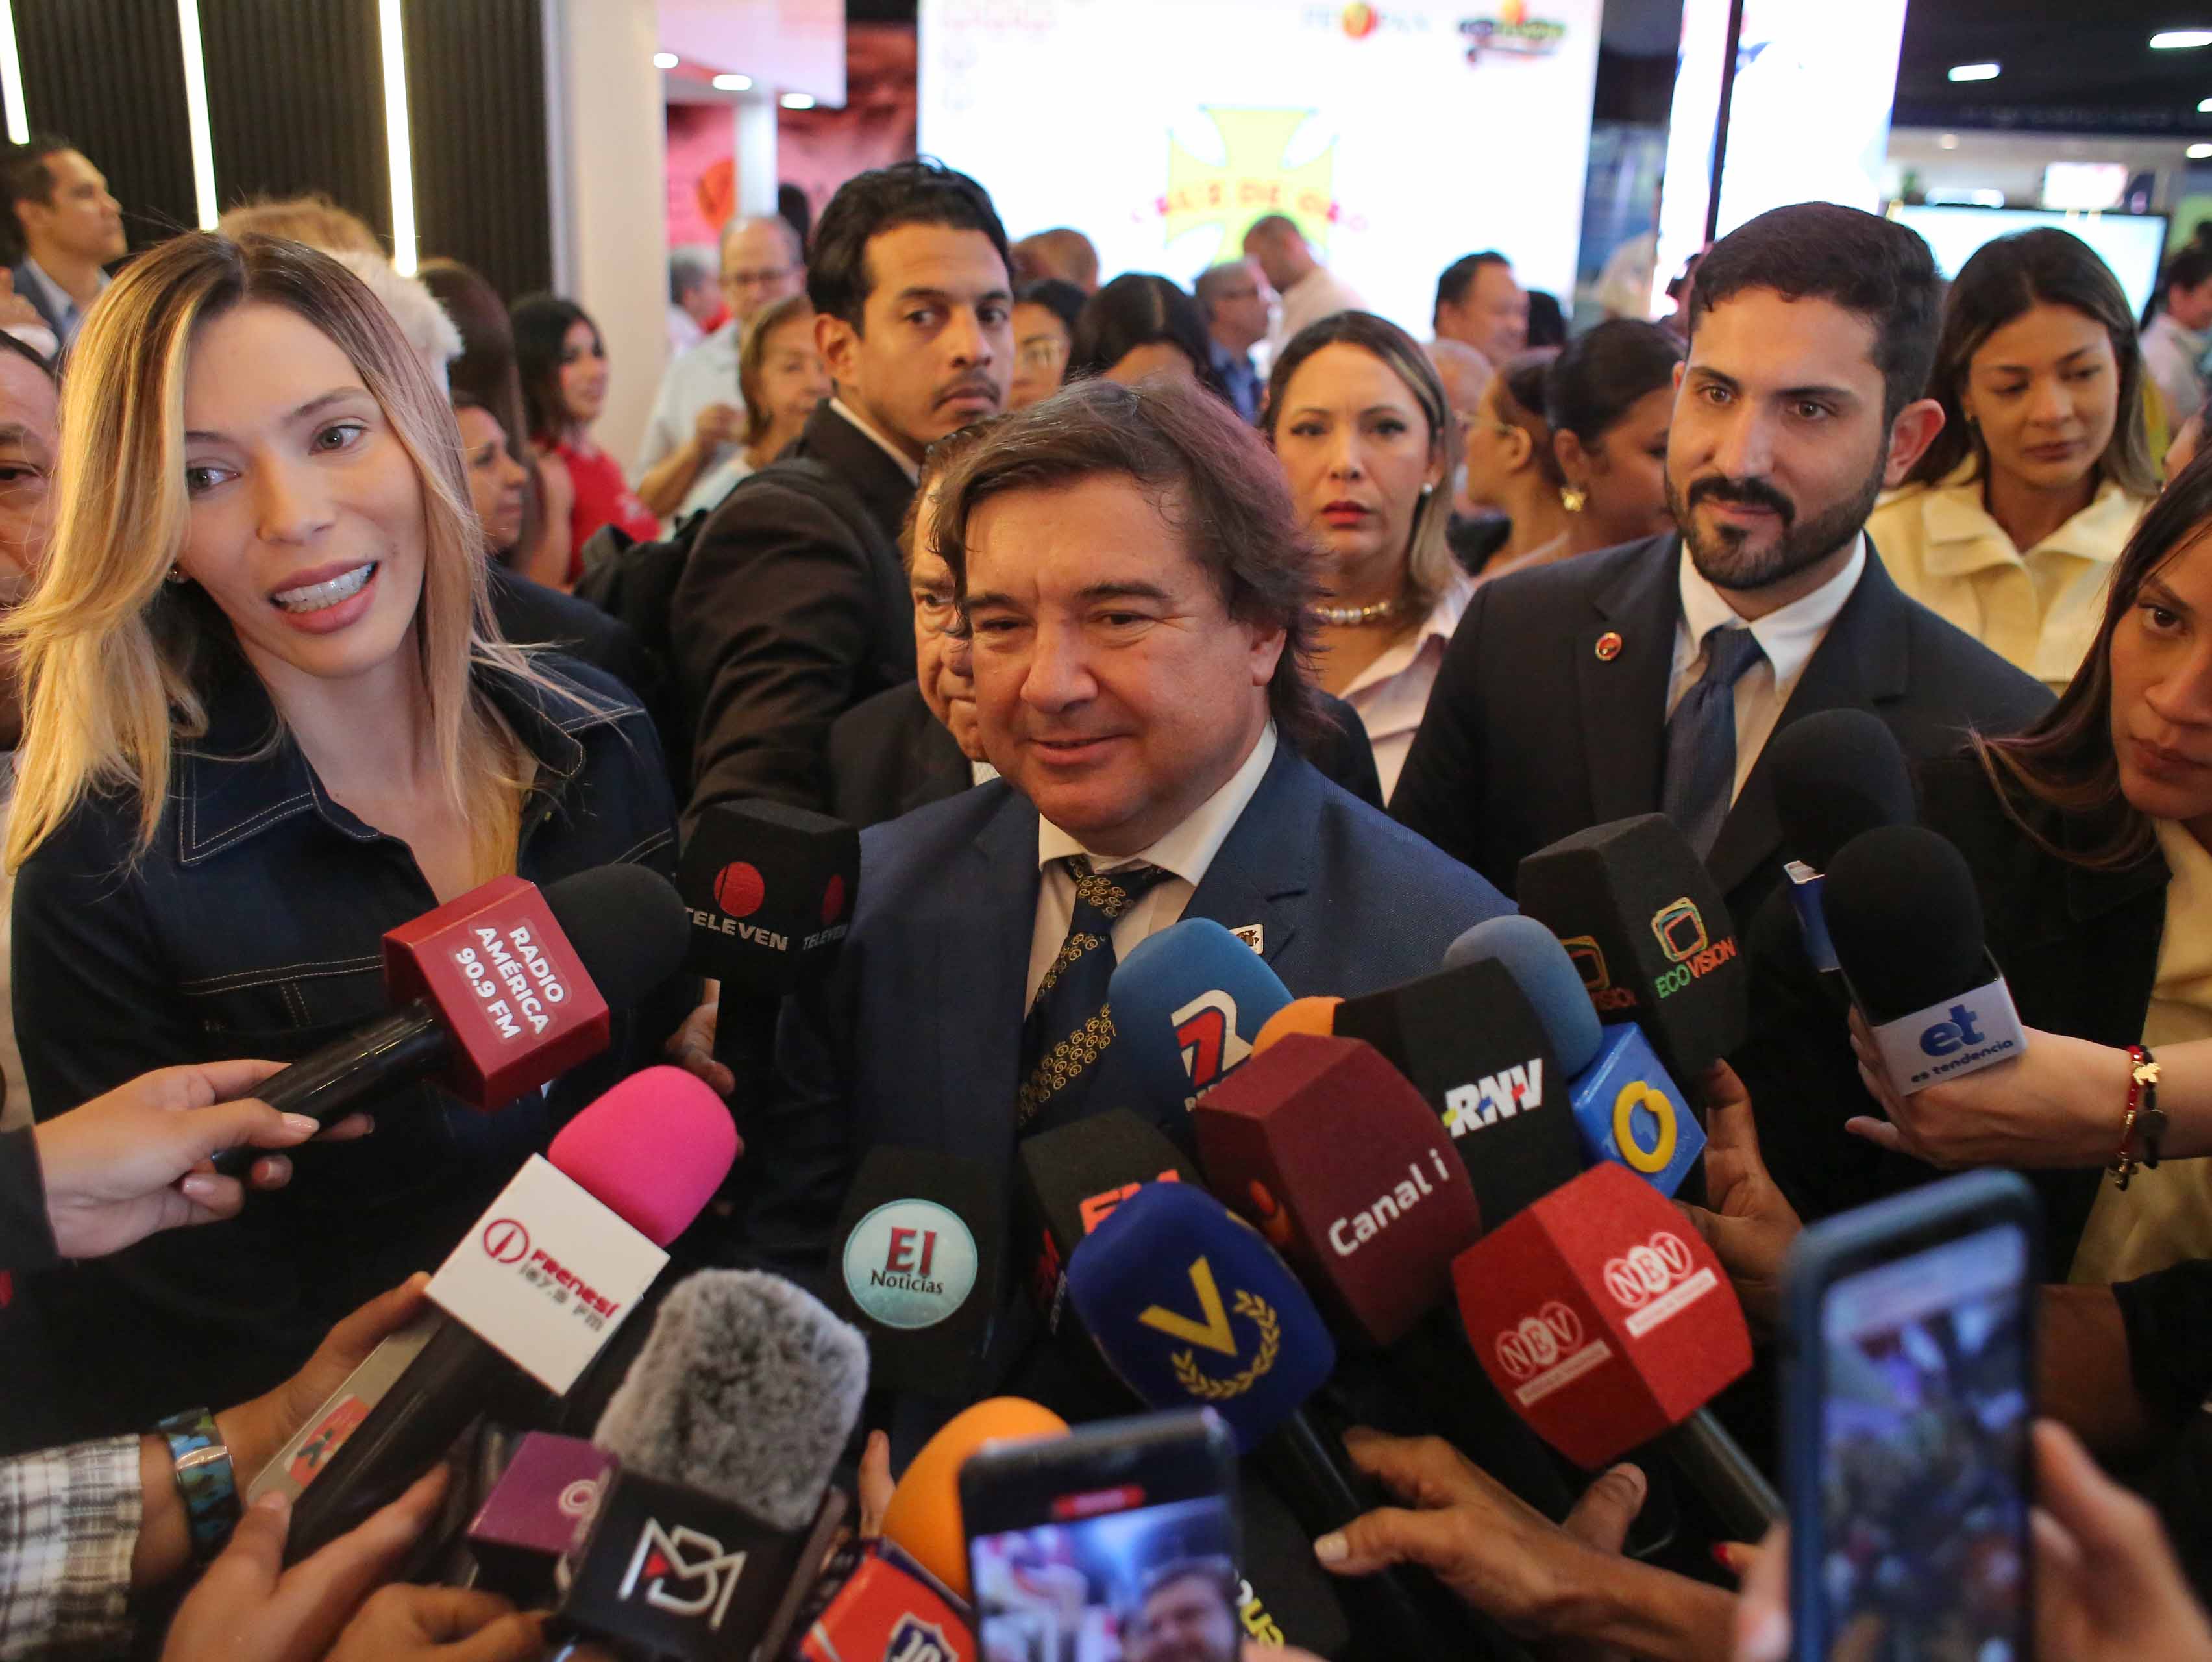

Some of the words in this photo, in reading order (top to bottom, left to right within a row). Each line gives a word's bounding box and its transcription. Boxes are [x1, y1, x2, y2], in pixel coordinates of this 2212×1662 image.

[456, 947, 497, 998] 90.9
[487, 999, 522, 1039] FM
[475, 927, 550, 1034] AMÉRICA
[509, 926, 565, 1003] RADIO
[1919, 1004, 1985, 1057] et
[1444, 1058, 1543, 1140] RNV
[1328, 1163, 1434, 1256] Canal
[1429, 1148, 1450, 1182] i
[870, 1268, 944, 1295] Noticias
